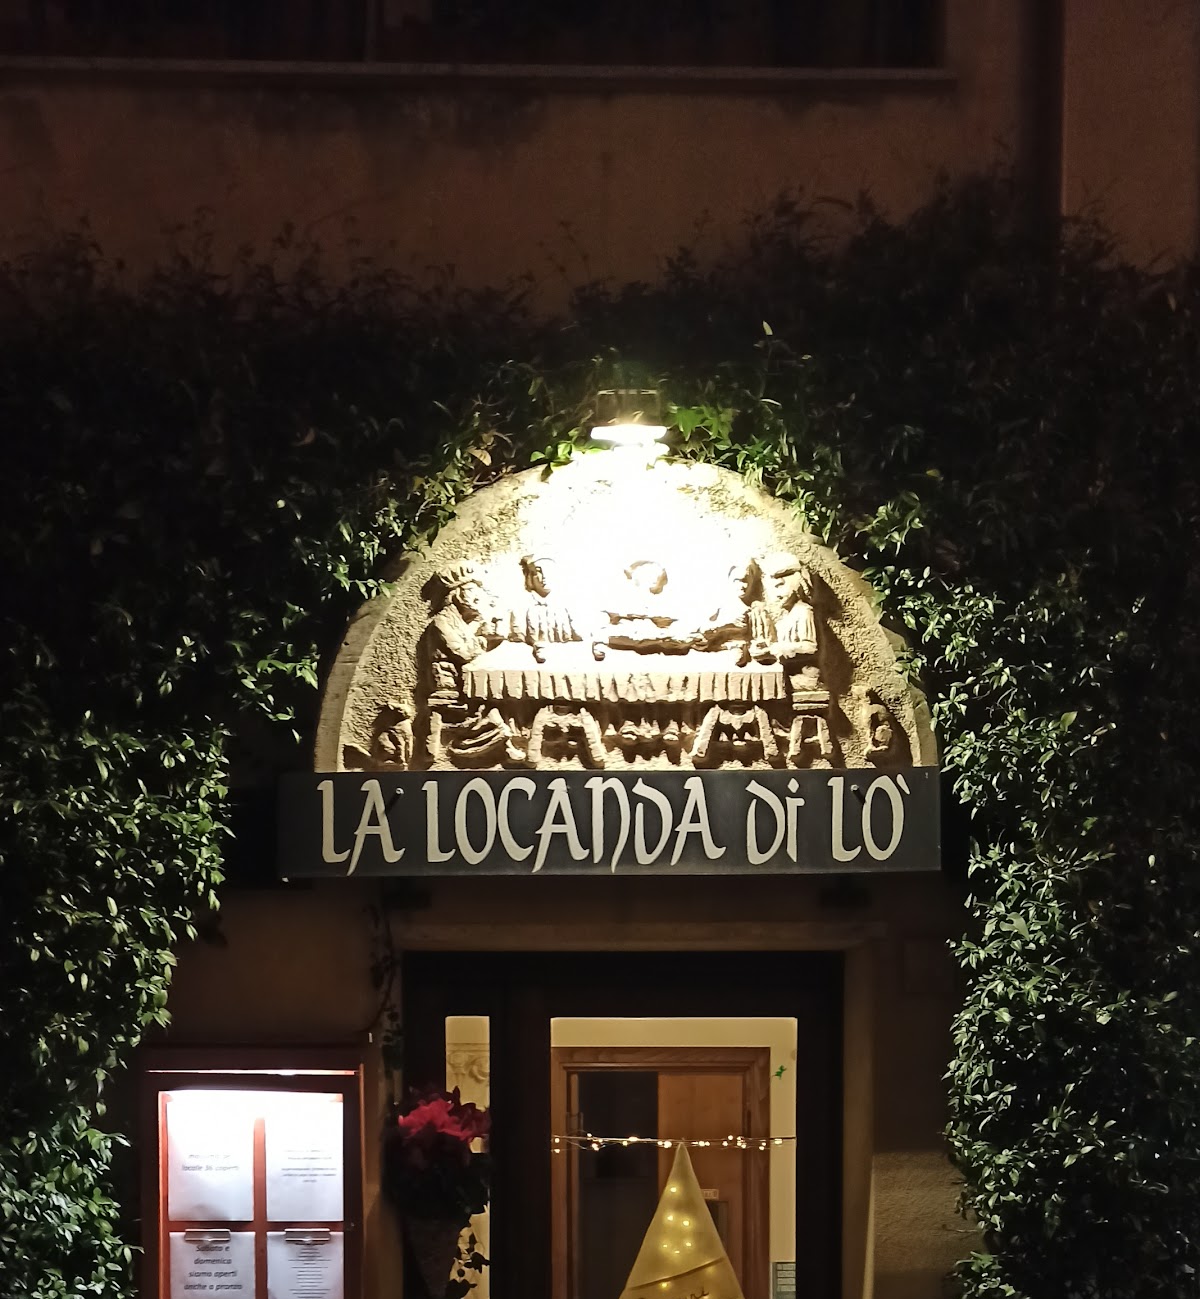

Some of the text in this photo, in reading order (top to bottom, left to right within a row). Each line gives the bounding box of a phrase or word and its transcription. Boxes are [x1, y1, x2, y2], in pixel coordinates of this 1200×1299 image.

[317, 779, 405, 876] LA
[422, 776, 726, 874] LOCANDA
[195, 1244, 223, 1252] Sabato
[193, 1257, 232, 1265] domenica
[188, 1269, 238, 1279] siamo aperti
[183, 1282, 207, 1290] anche
[215, 1284, 243, 1292] pranzo
